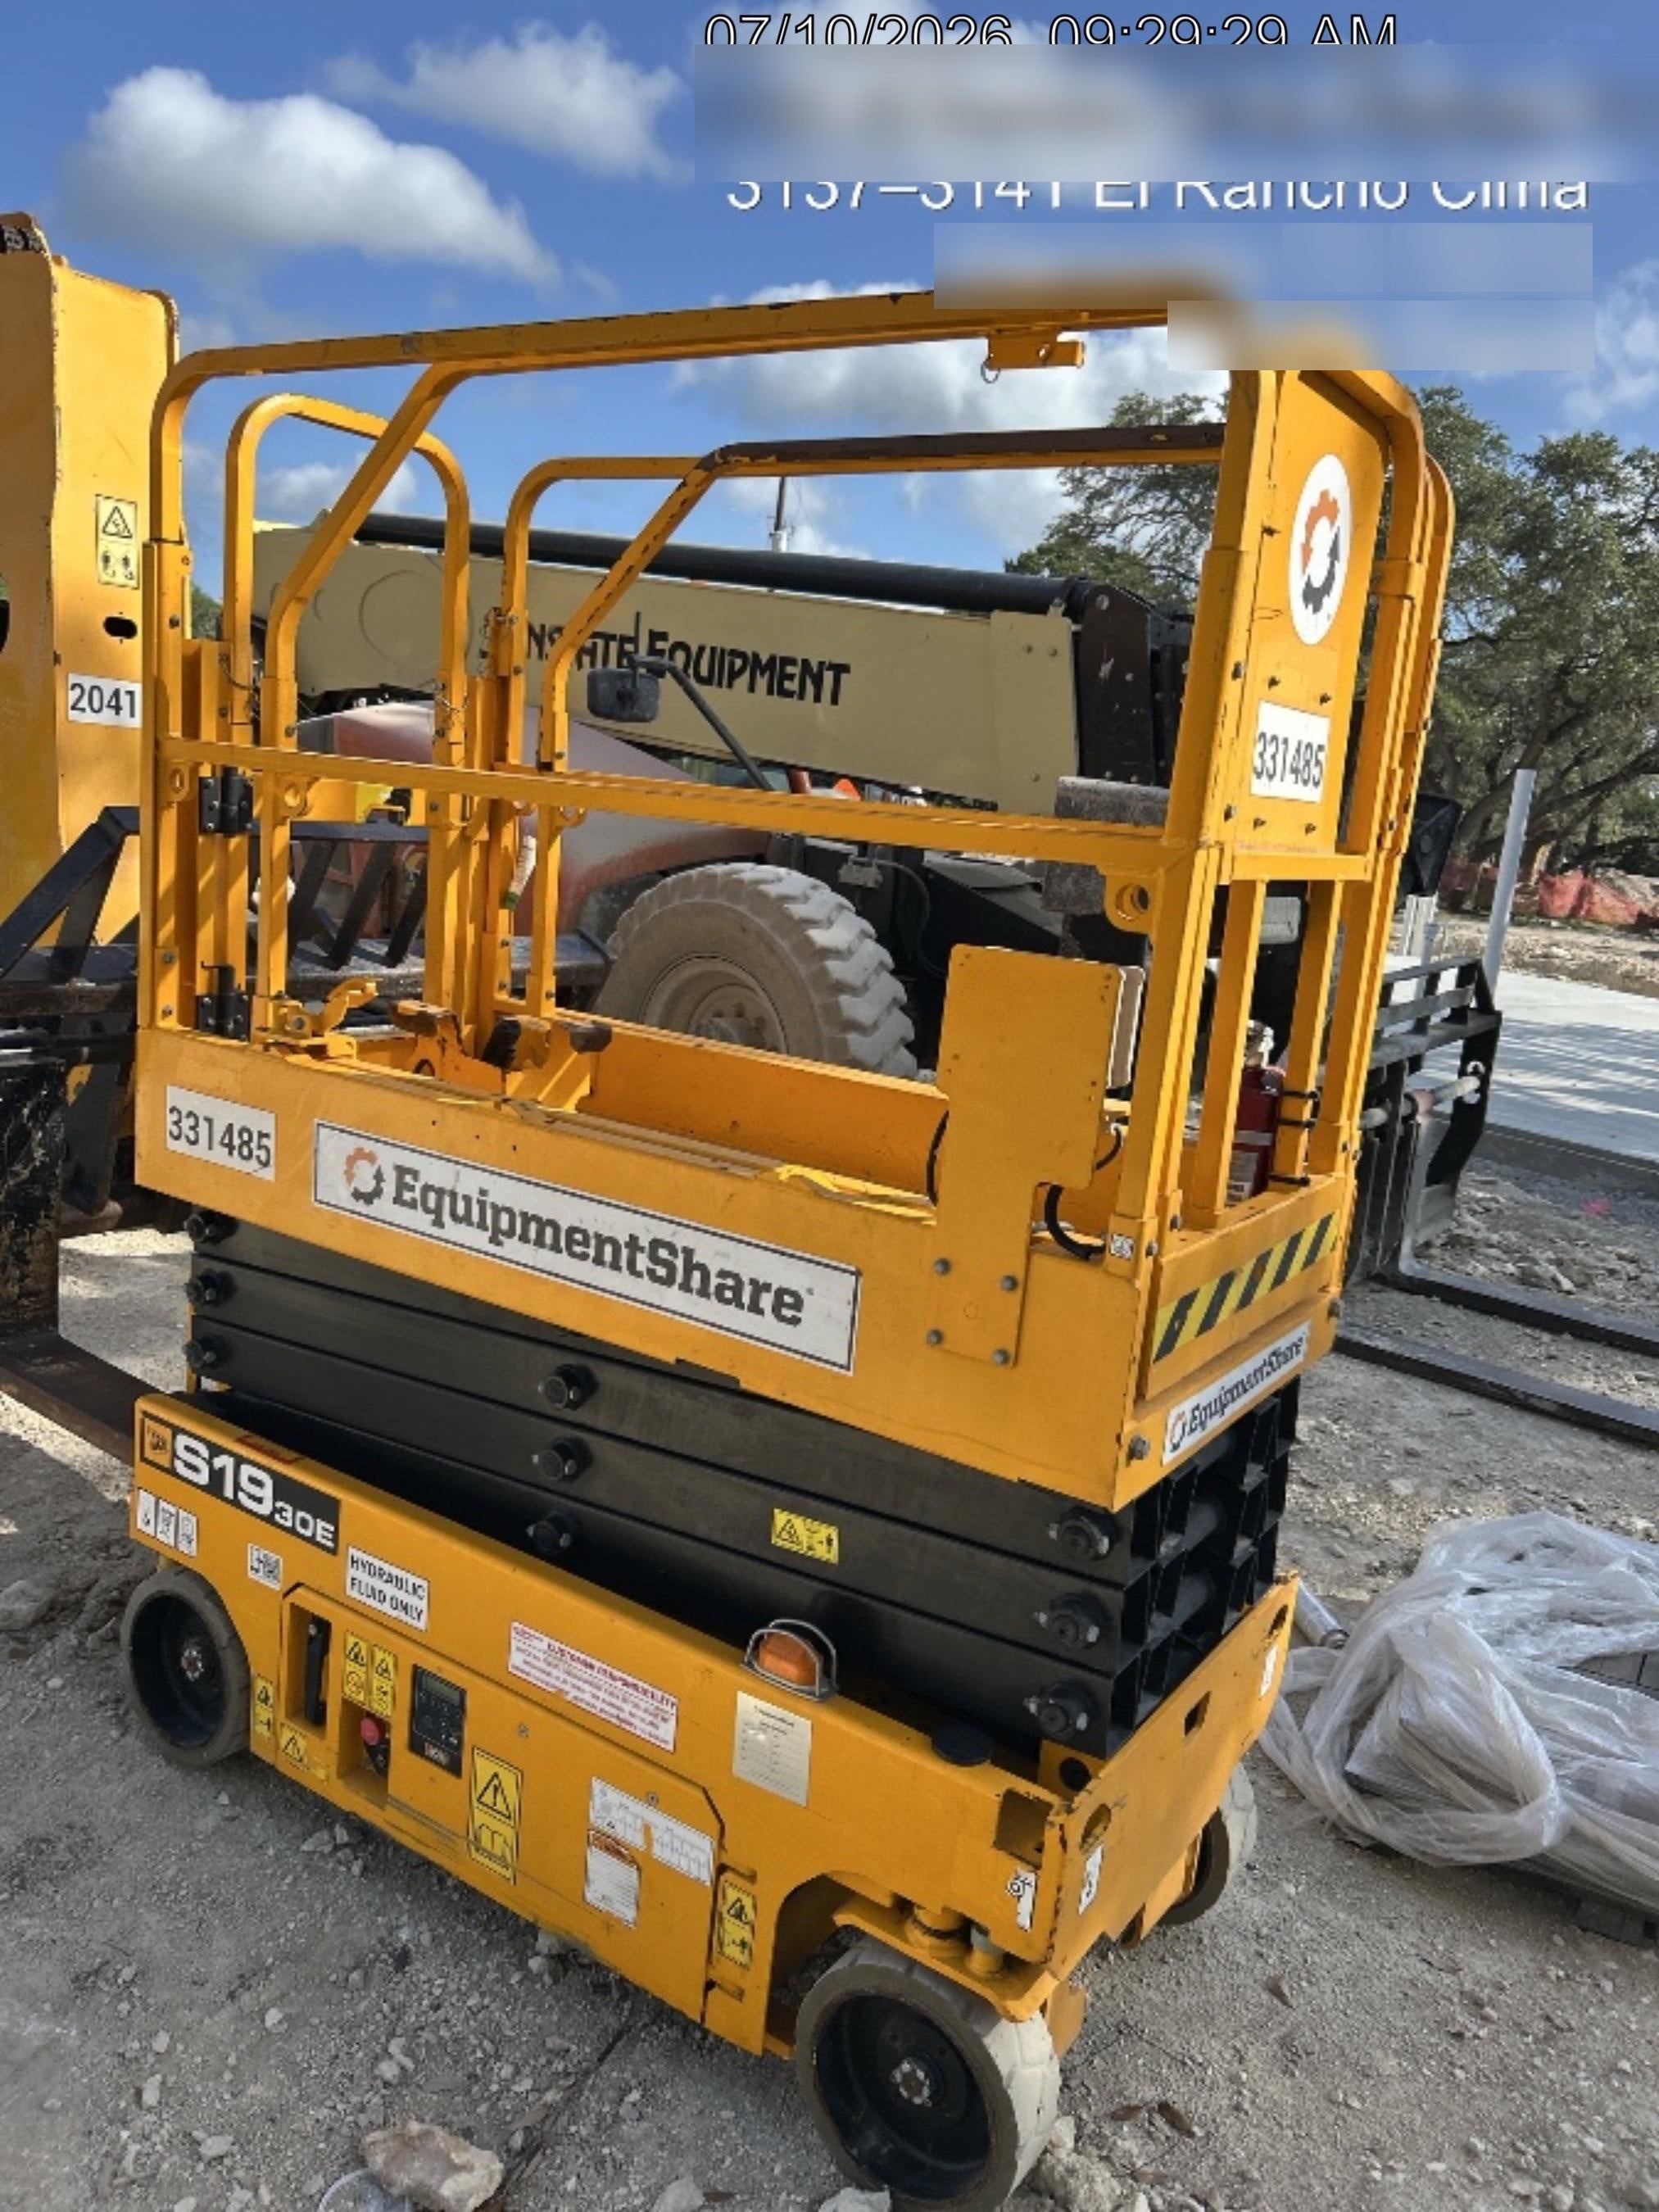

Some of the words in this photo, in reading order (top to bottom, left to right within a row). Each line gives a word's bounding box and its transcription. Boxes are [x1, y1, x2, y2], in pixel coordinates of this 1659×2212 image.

[70, 682, 136, 718] 2041
[1253, 732, 1325, 787] 331485
[169, 1106, 271, 1167] 331485
[392, 1164, 804, 1327] EquipmentShare
[350, 1554, 425, 1601] HYDRAULIC
[350, 1576, 387, 1605] FLUID
[390, 1594, 424, 1622] ONLY
